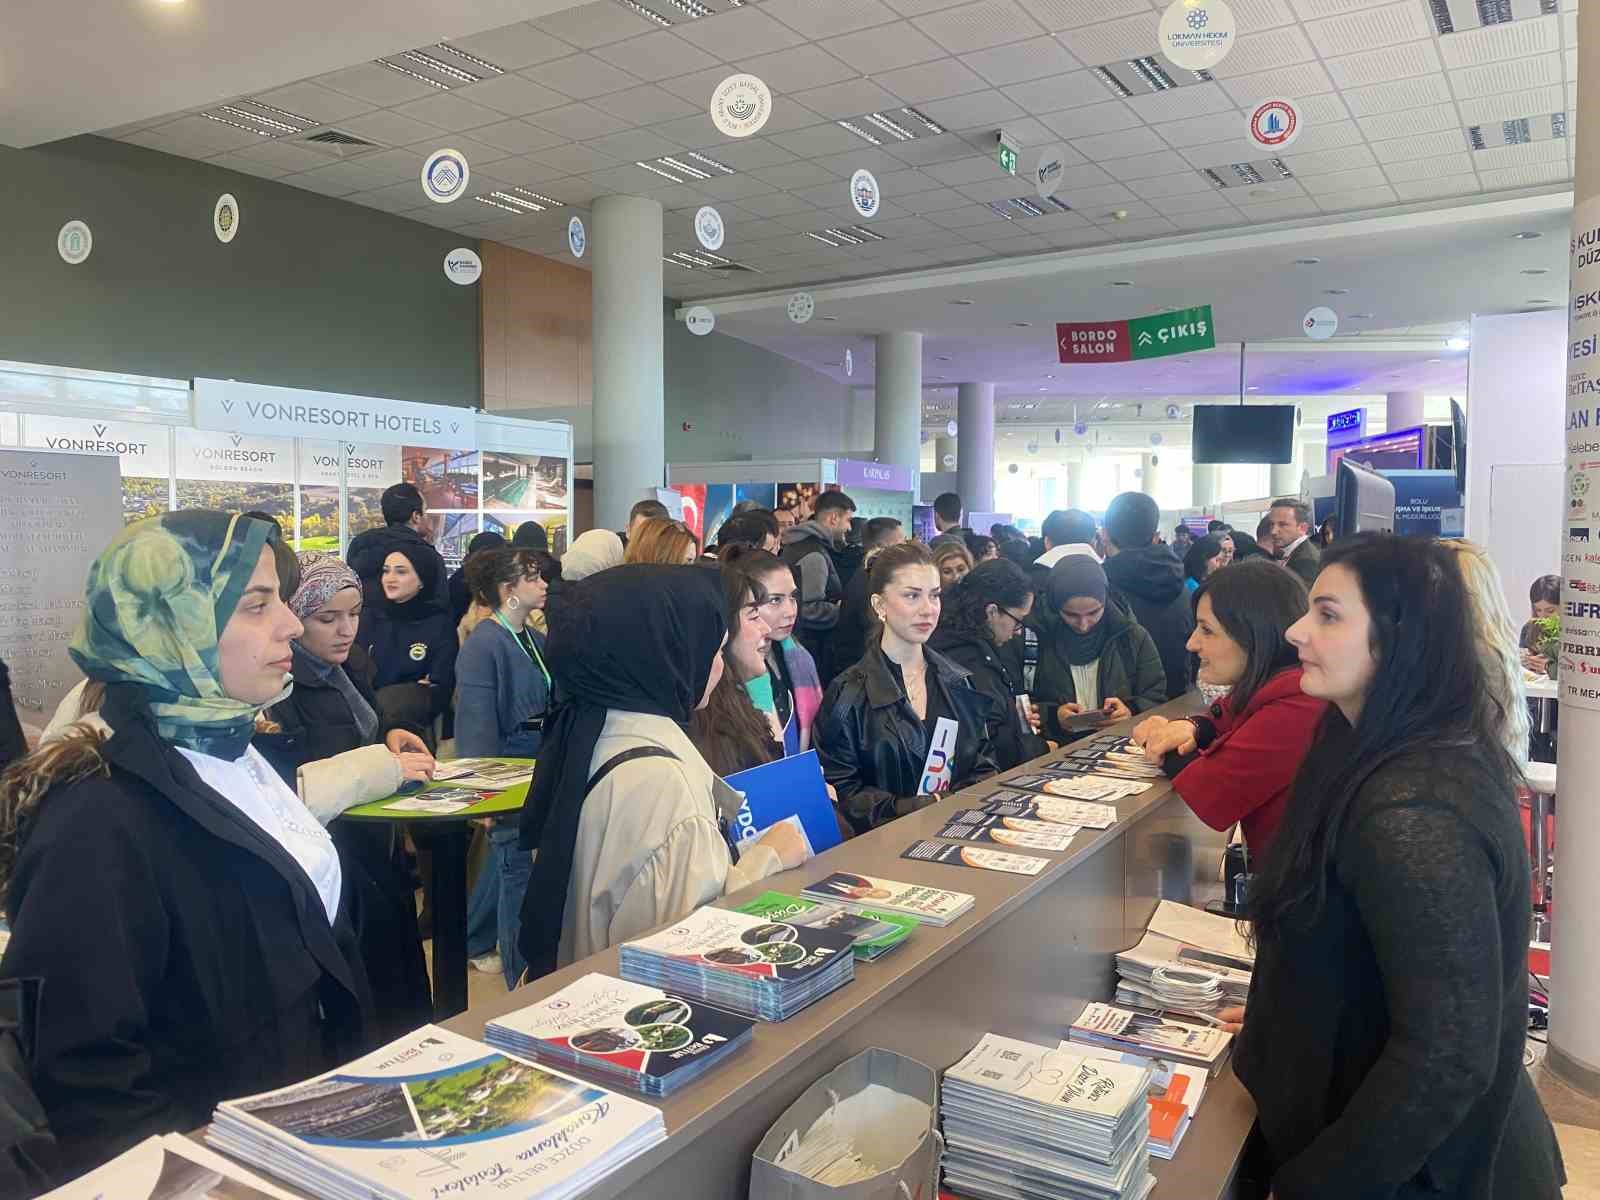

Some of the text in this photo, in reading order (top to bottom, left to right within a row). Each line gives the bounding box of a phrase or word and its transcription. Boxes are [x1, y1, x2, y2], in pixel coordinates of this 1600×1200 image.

[1071, 329, 1117, 342] BORDO
[1157, 321, 1207, 344] ÇIKIŞ
[1073, 343, 1114, 355] SALON
[247, 401, 441, 435] VONRESORT HOTELS
[46, 436, 148, 456] VONRESORT
[193, 447, 277, 464] VONRESORT
[313, 455, 385, 471] VONESORT
[1, 470, 68, 481] VONRESORT
